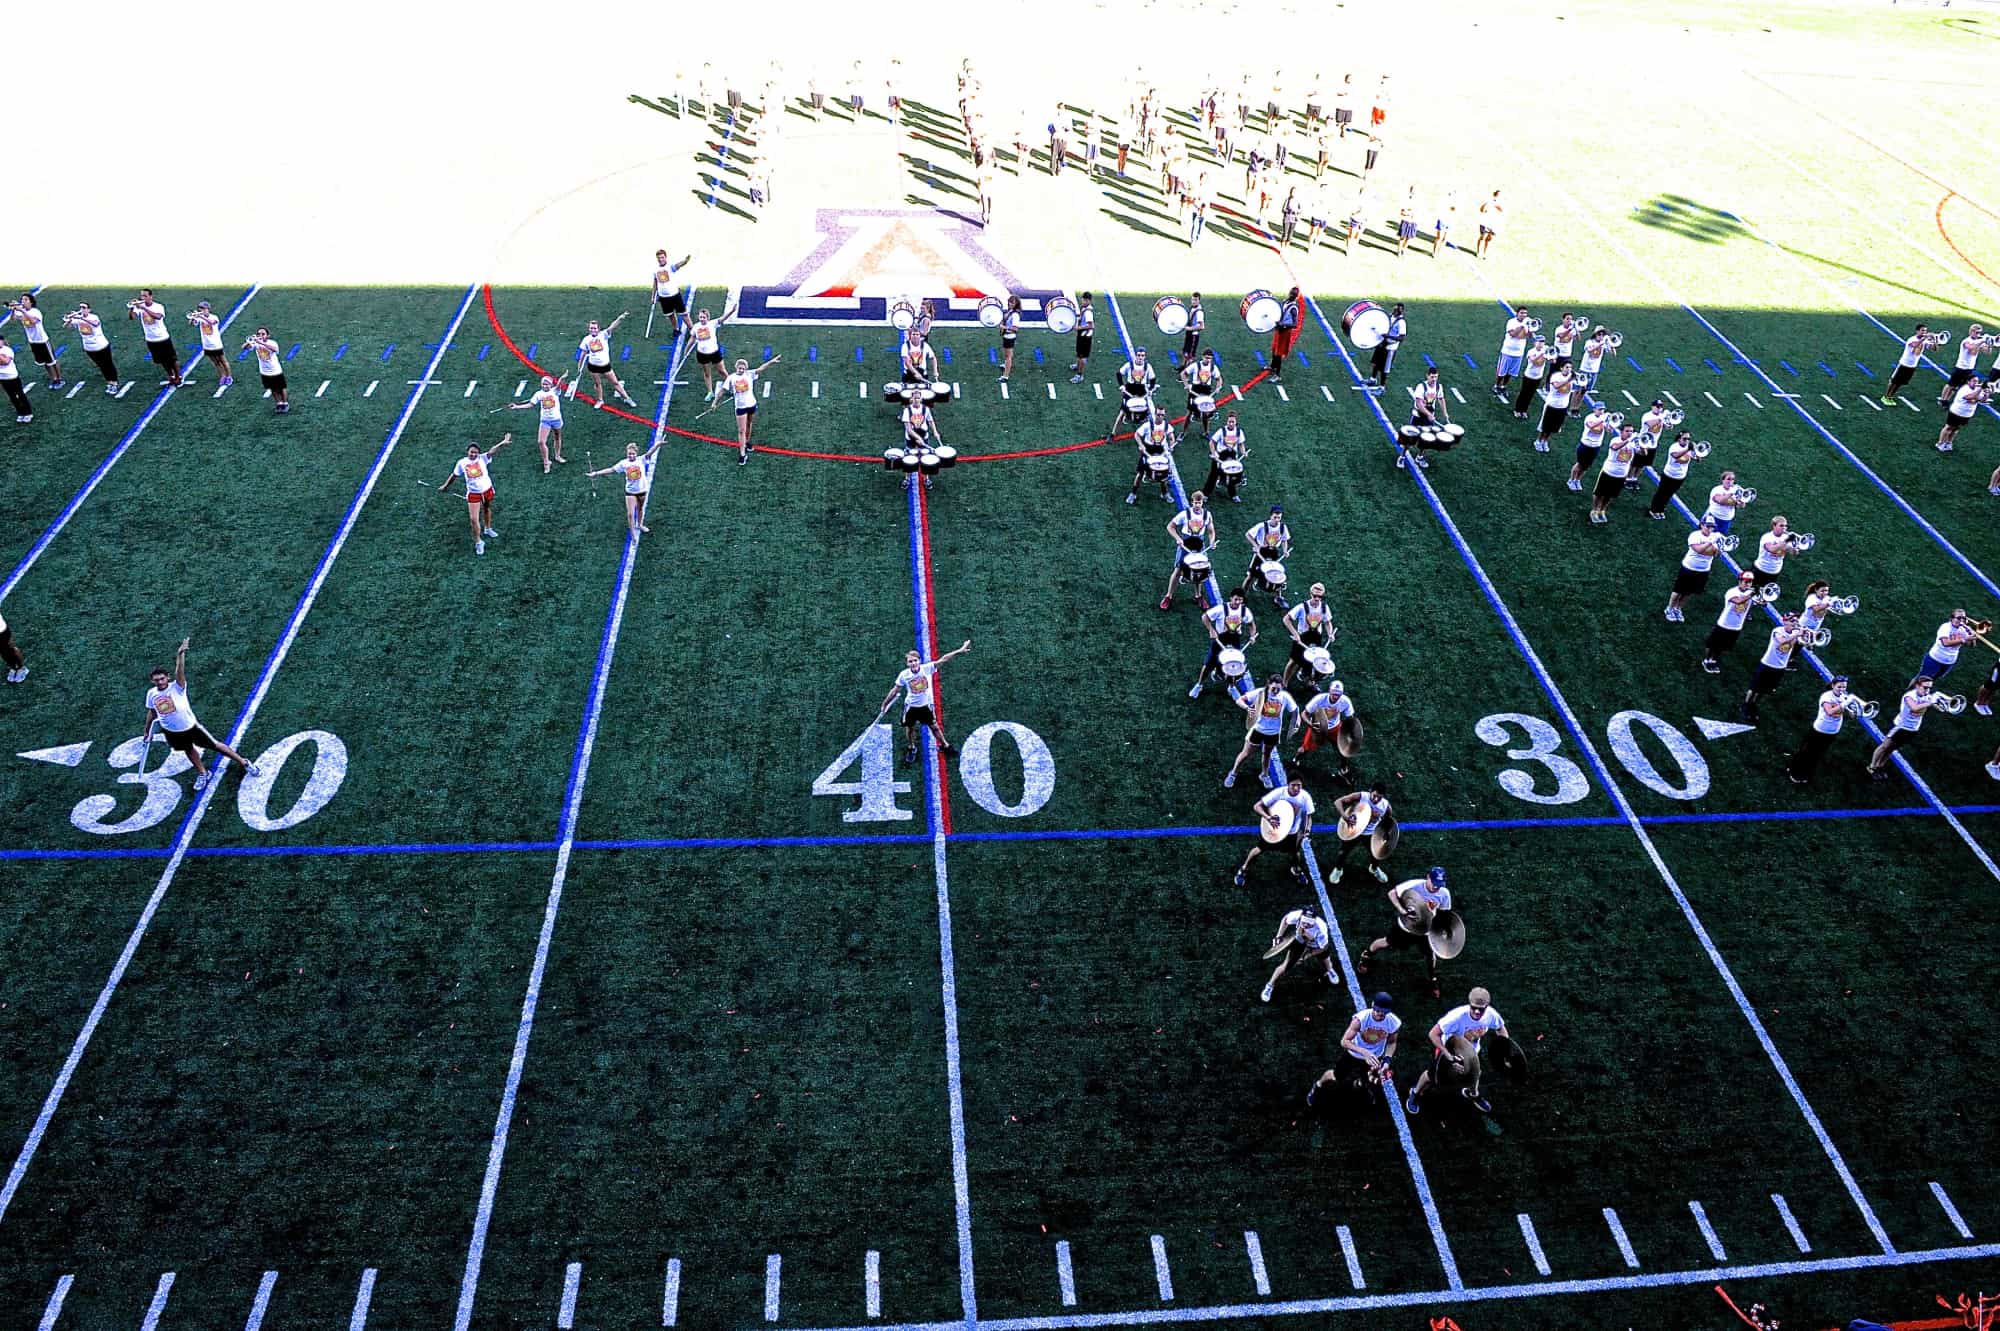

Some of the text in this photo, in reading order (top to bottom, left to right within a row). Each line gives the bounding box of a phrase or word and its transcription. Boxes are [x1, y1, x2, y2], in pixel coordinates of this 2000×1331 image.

[736, 208, 1066, 322] A
[70, 730, 348, 834] 30
[812, 721, 1056, 822] 40
[1474, 710, 1710, 805] 30
